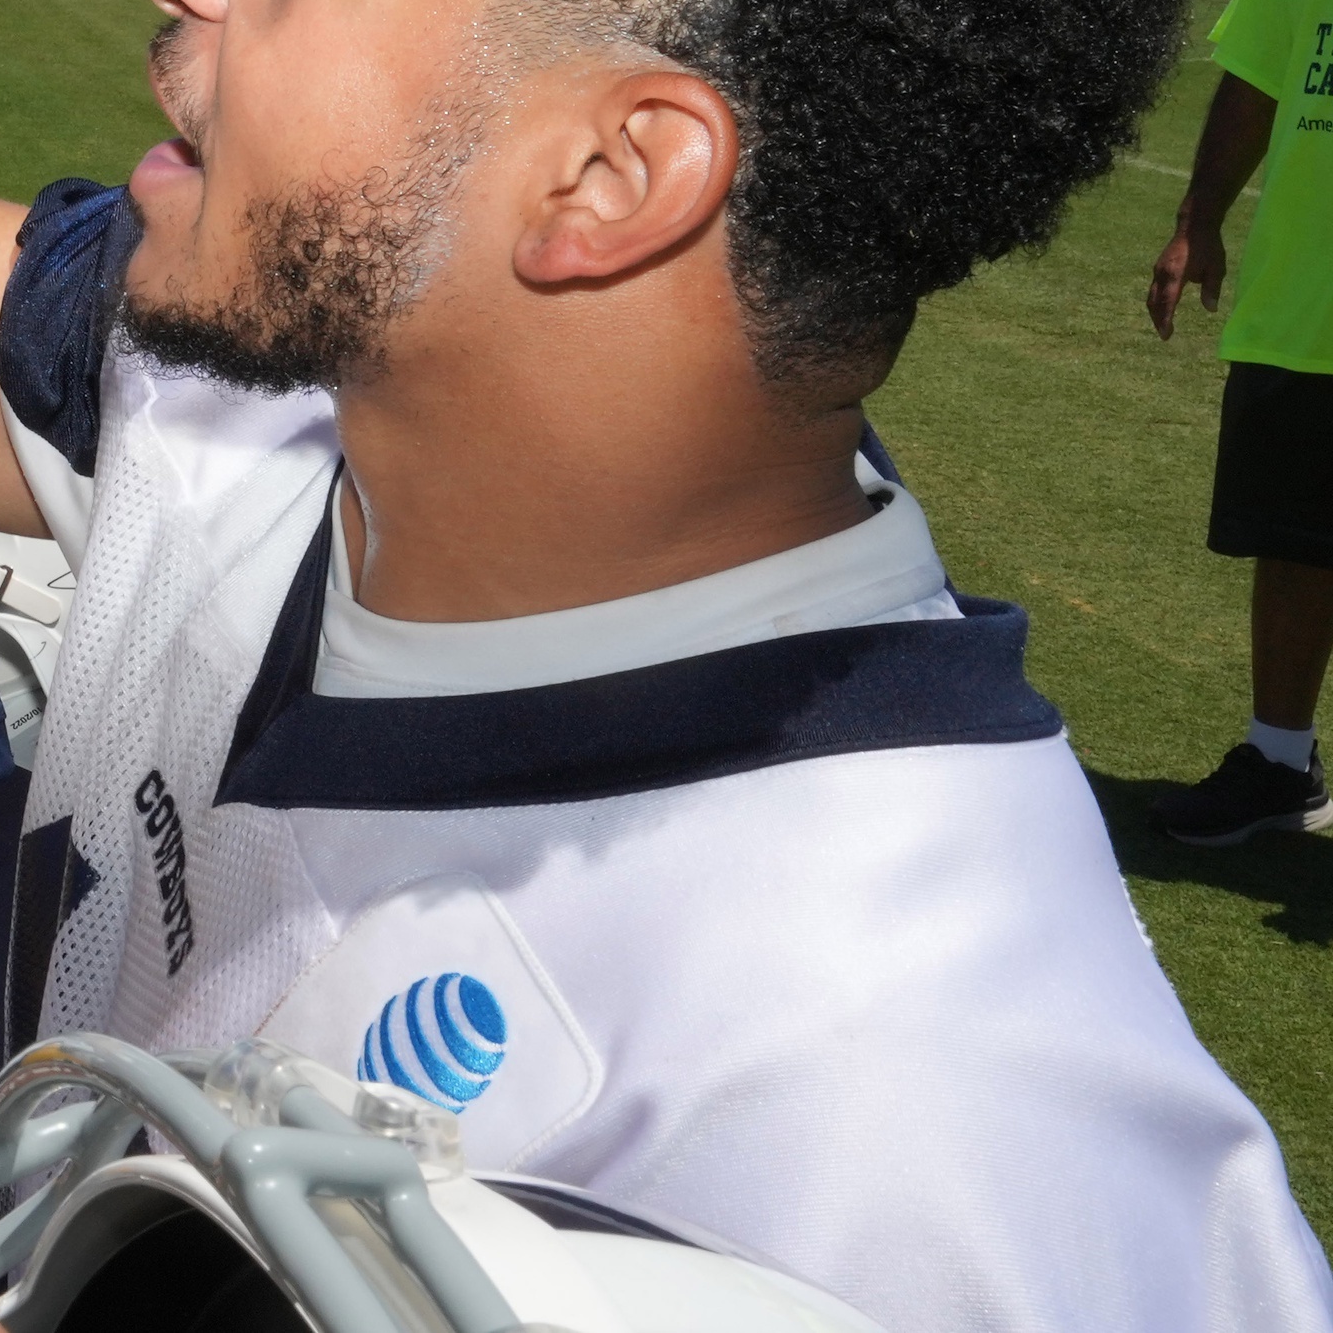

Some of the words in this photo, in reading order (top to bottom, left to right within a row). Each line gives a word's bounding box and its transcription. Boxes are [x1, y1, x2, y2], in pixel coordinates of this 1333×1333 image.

[1316, 23, 1333, 56] T
[1296, 116, 1333, 133] Ame
[10, 707, 42, 730] 10/2022
[134, 769, 194, 980] COWBOYS
